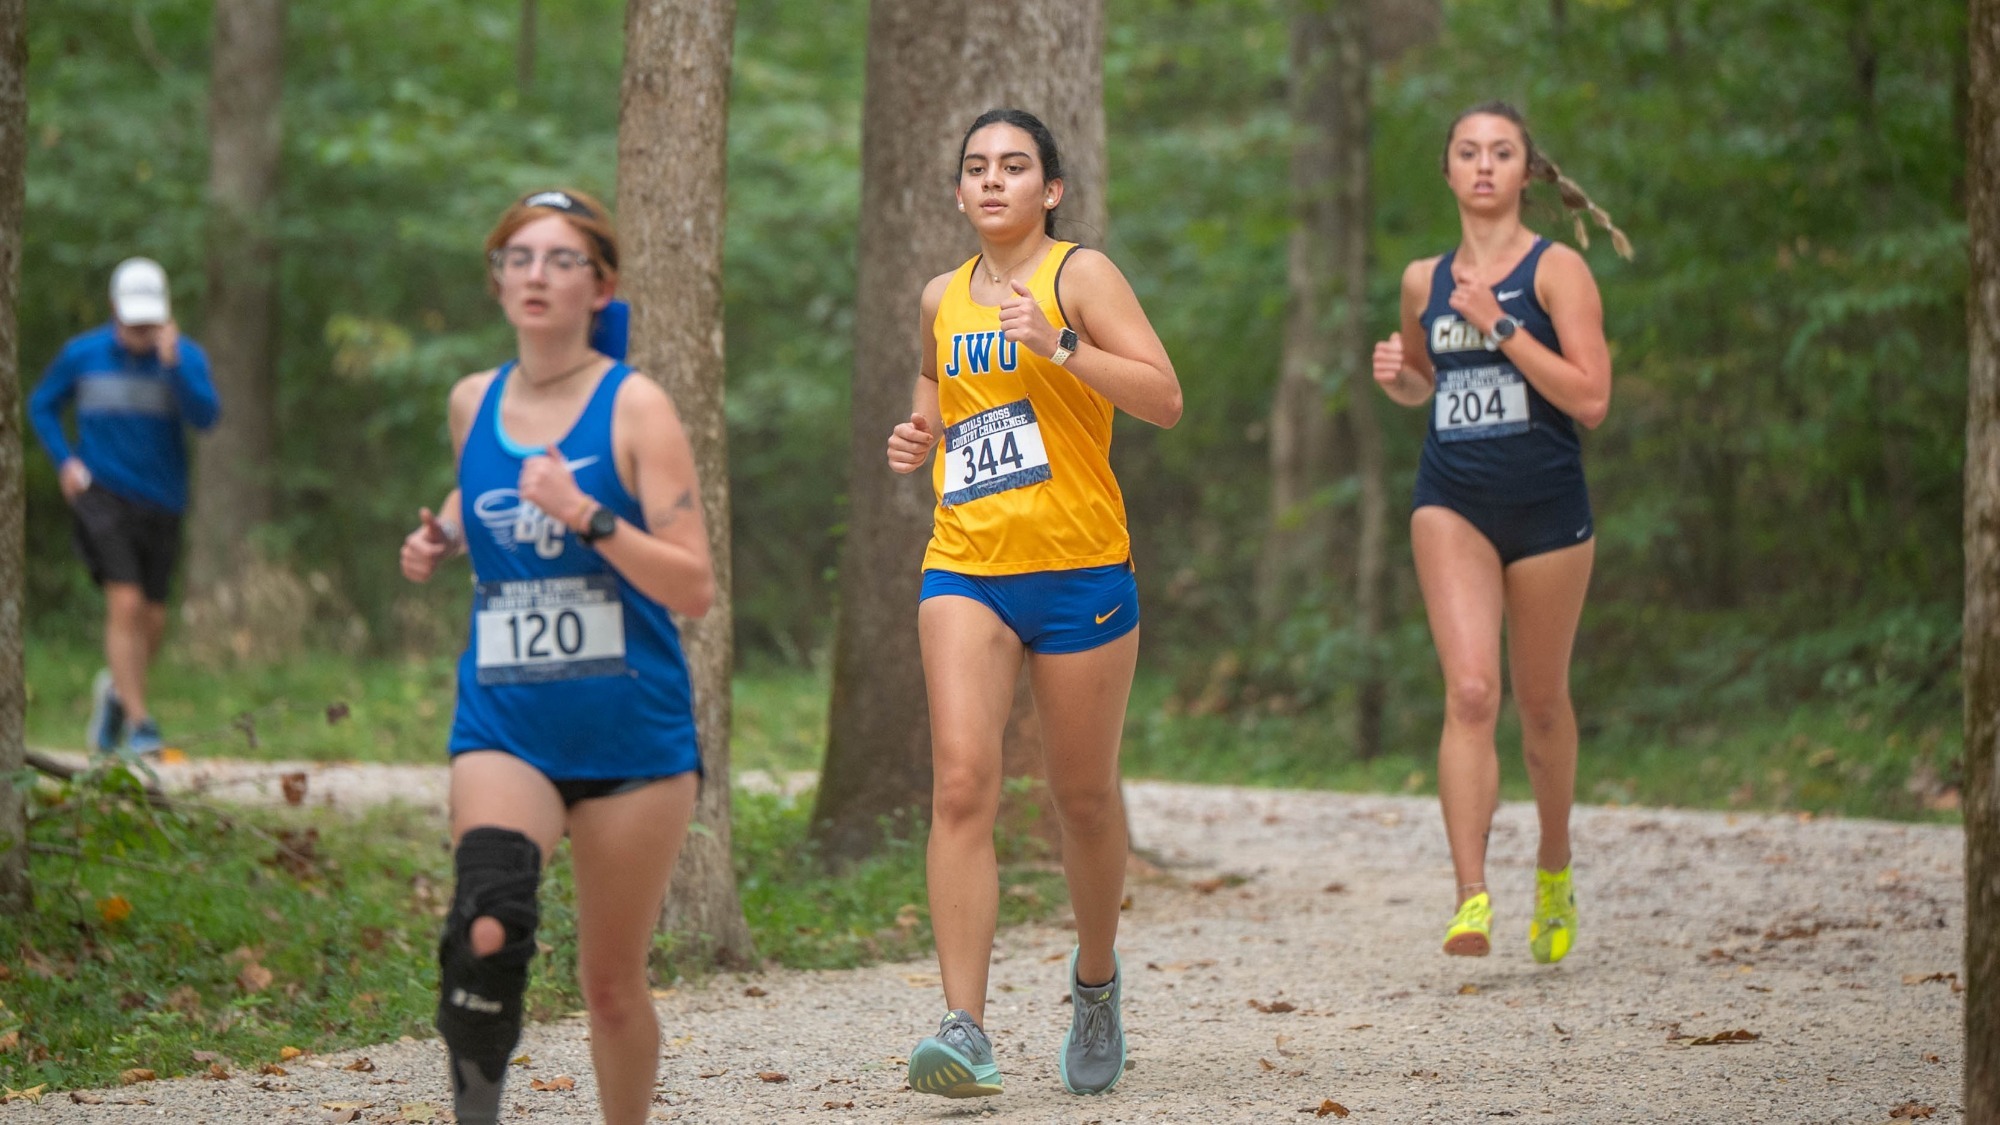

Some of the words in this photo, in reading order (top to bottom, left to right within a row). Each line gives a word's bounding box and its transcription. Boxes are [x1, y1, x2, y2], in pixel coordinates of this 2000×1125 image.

[945, 331, 1018, 377] JWU
[959, 416, 982, 435] ROYALS
[983, 407, 1011, 425] CROSS
[1447, 387, 1506, 425] 204
[951, 430, 978, 449] COUNTRY
[979, 414, 1028, 436] CHALLENGE
[962, 431, 1024, 485] 344
[507, 608, 585, 660] 120
